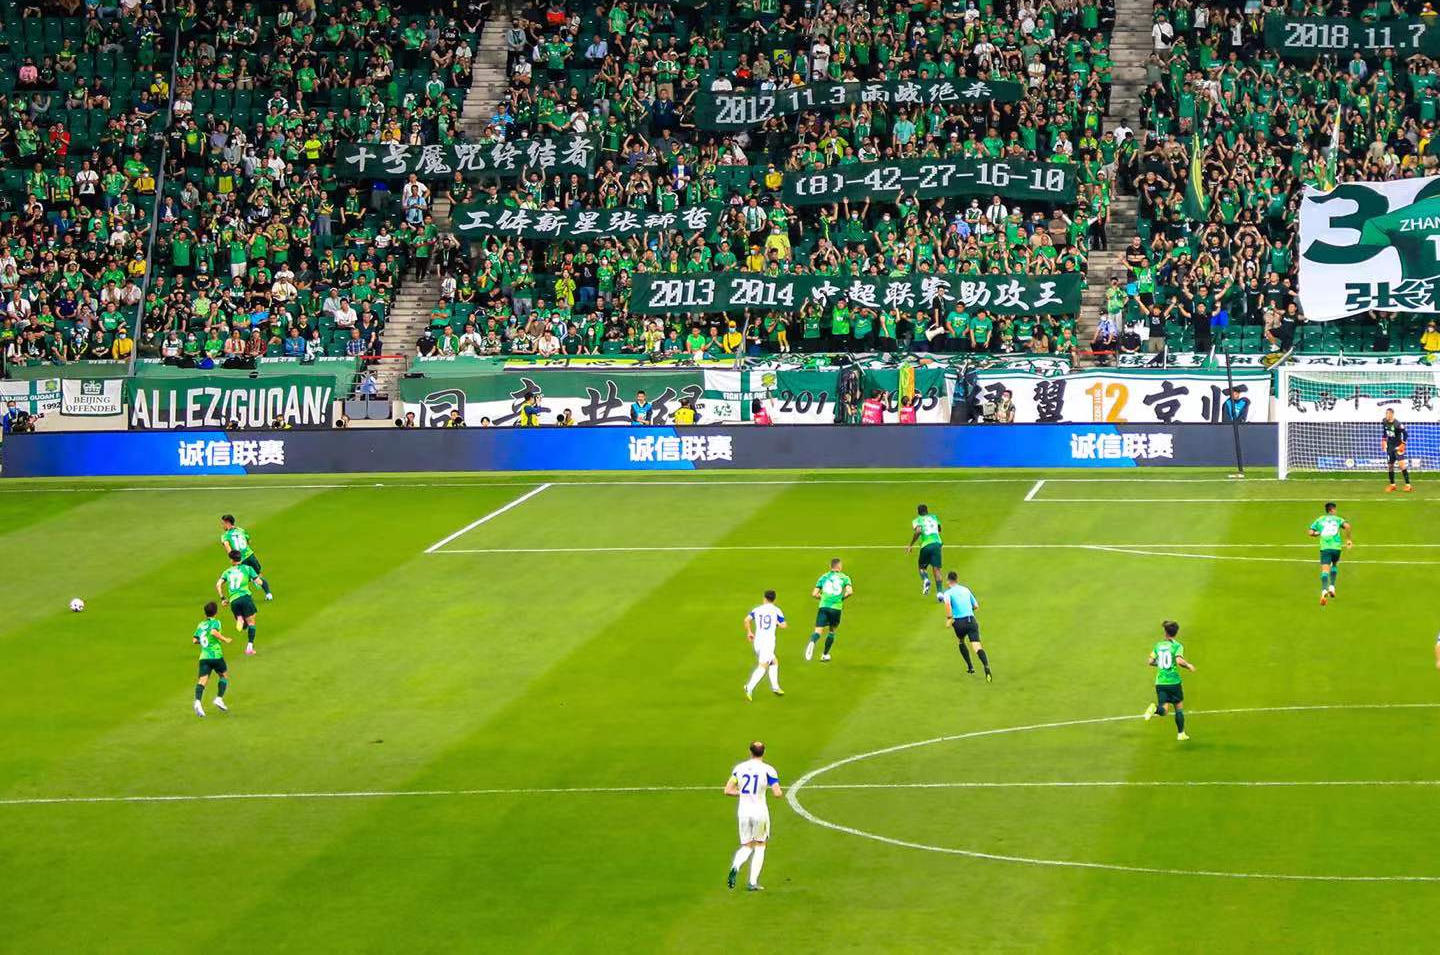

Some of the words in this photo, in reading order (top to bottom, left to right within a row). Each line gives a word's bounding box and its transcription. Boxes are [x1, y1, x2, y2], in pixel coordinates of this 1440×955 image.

[1284, 24, 1425, 49] 2018.11.7
[648, 279, 715, 309] 2013
[729, 279, 794, 307] 2014
[66, 404, 117, 413] OFFENDER
[74, 396, 110, 404] BEIJING
[179, 439, 285, 467] 诚信联赛
[628, 435, 733, 462] 诚信联赛
[1070, 432, 1174, 460] 诚信联赛
[758, 614, 772, 630] 19
[1158, 650, 1172, 669] 10
[741, 774, 759, 795] 21
